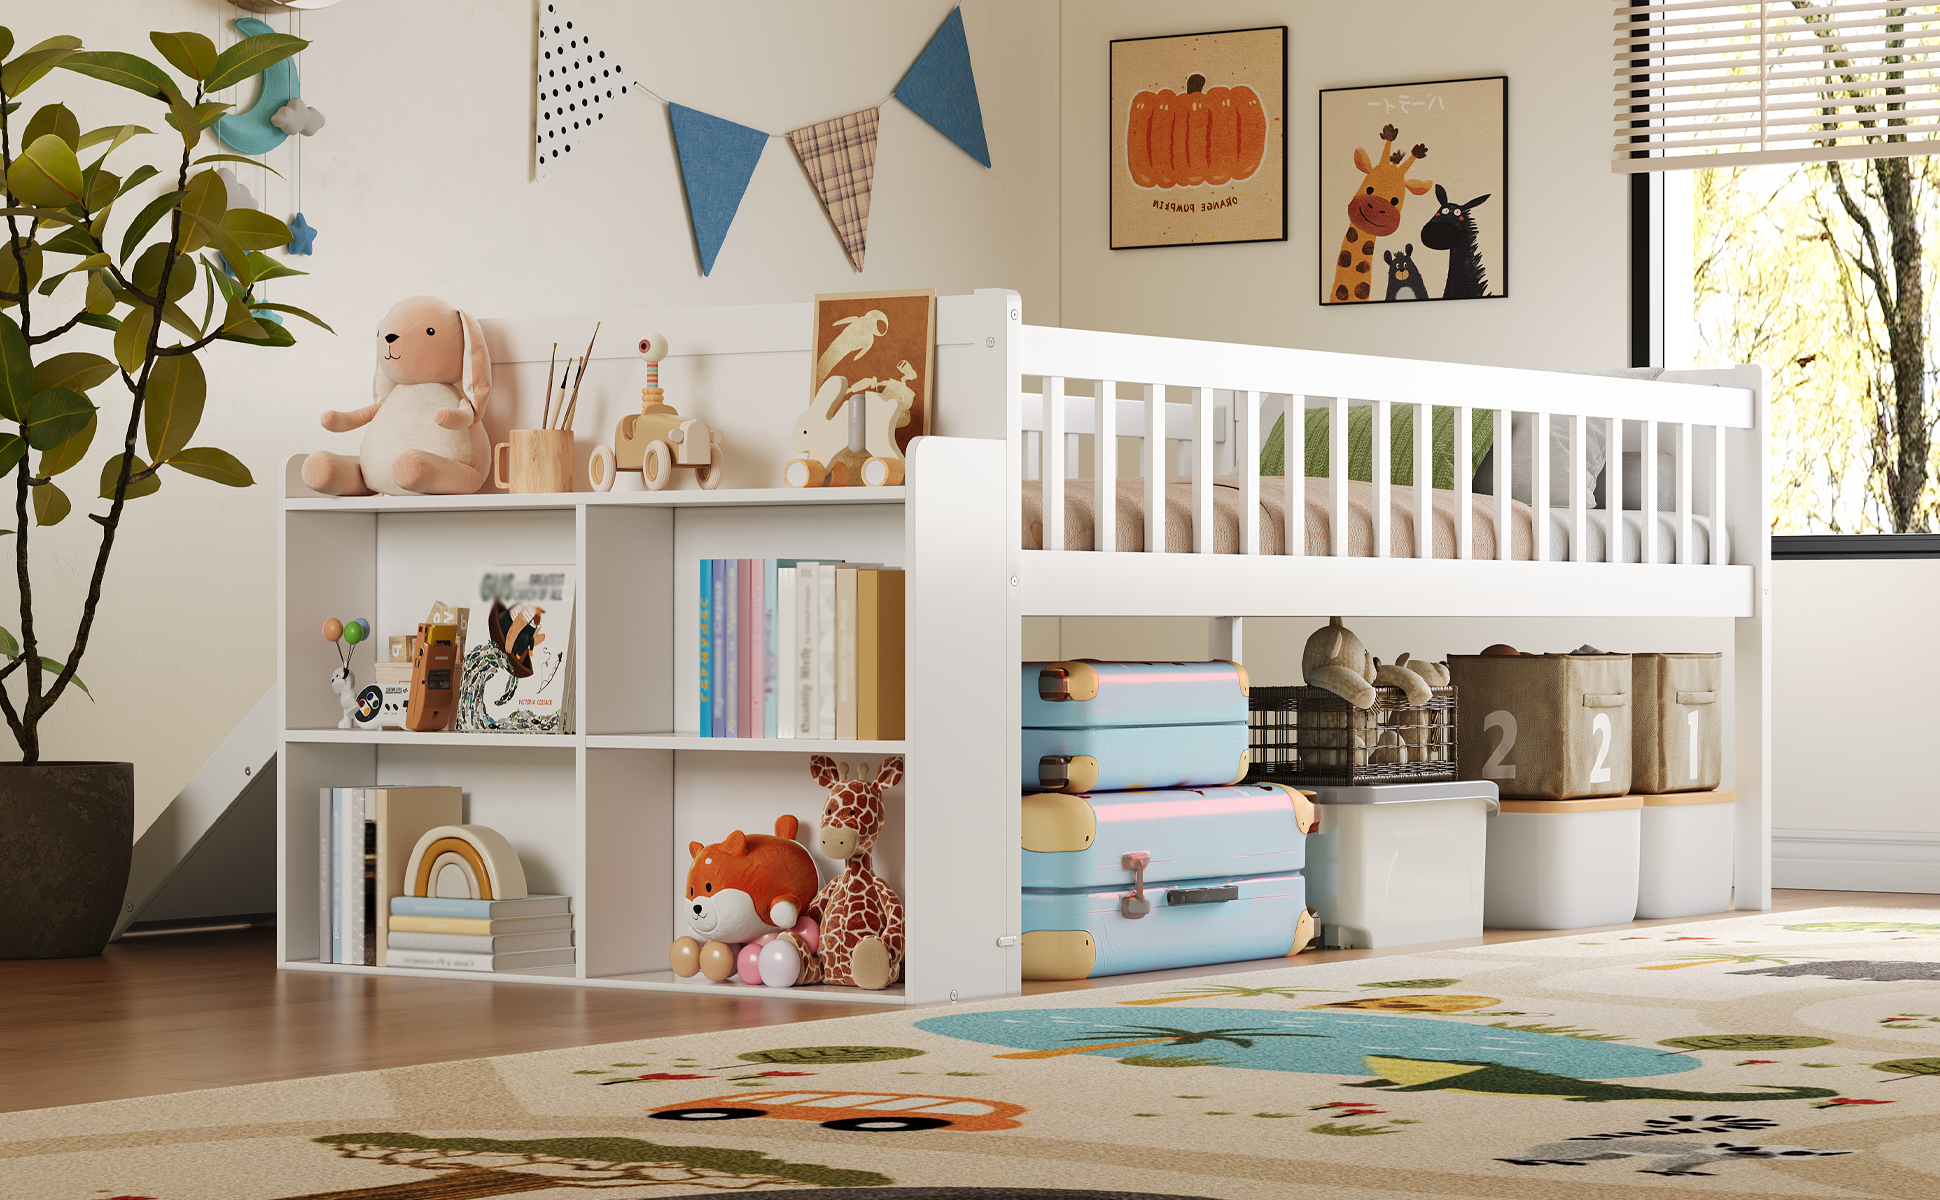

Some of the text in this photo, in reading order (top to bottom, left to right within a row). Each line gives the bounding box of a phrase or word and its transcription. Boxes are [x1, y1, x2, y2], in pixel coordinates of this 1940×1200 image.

[1481, 709, 1518, 779] 2
[1589, 712, 1612, 783] 2
[1687, 709, 1699, 780] 1
